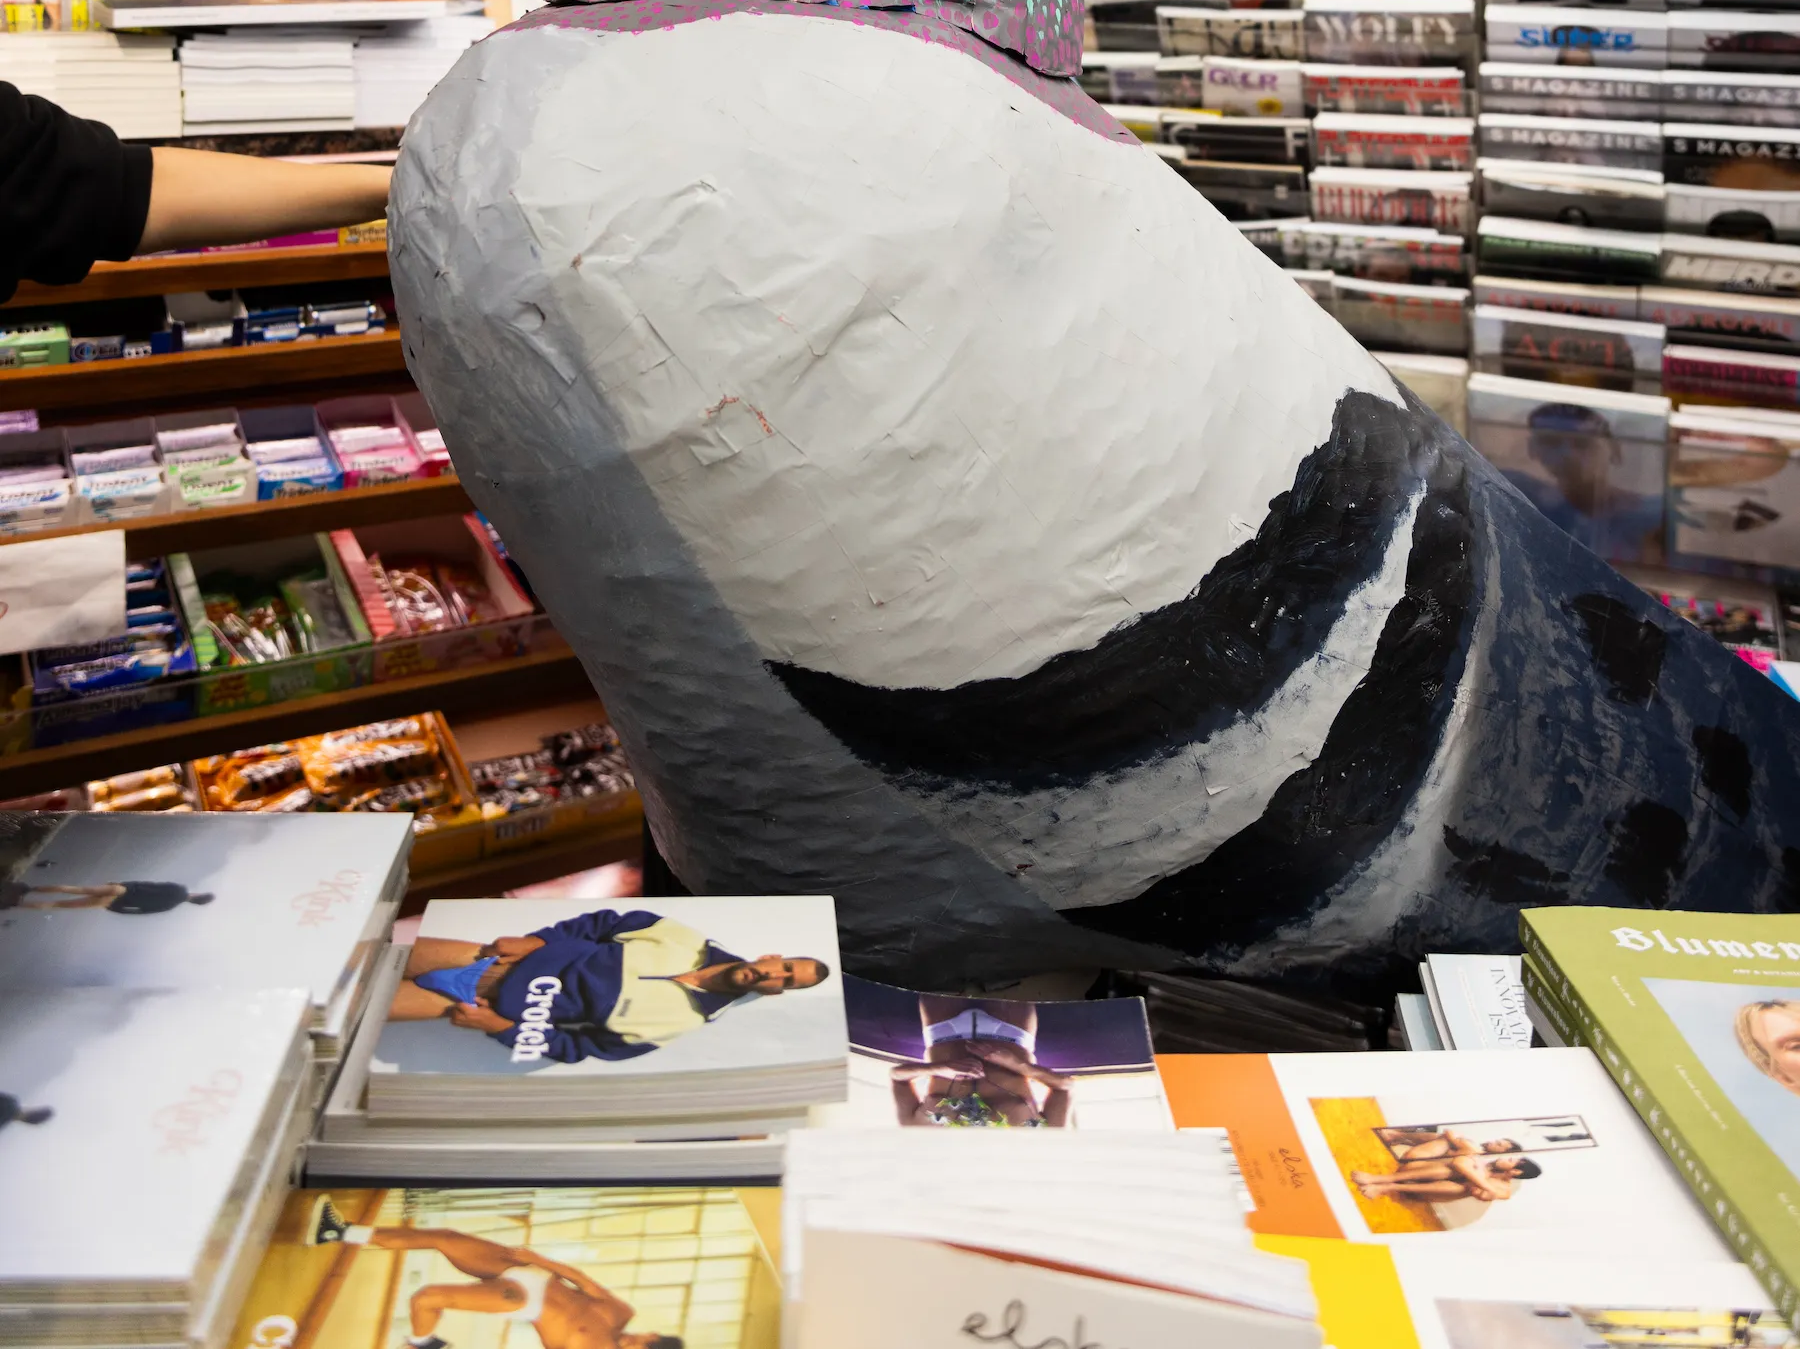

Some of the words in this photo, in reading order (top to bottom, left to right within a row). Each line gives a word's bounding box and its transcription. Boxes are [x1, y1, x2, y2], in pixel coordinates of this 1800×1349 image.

[1513, 79, 1651, 99] MAGAZINE
[1513, 130, 1650, 150] MAGAZINE
[1609, 926, 1800, 962] Blumen
[510, 975, 563, 1063] Crotch
